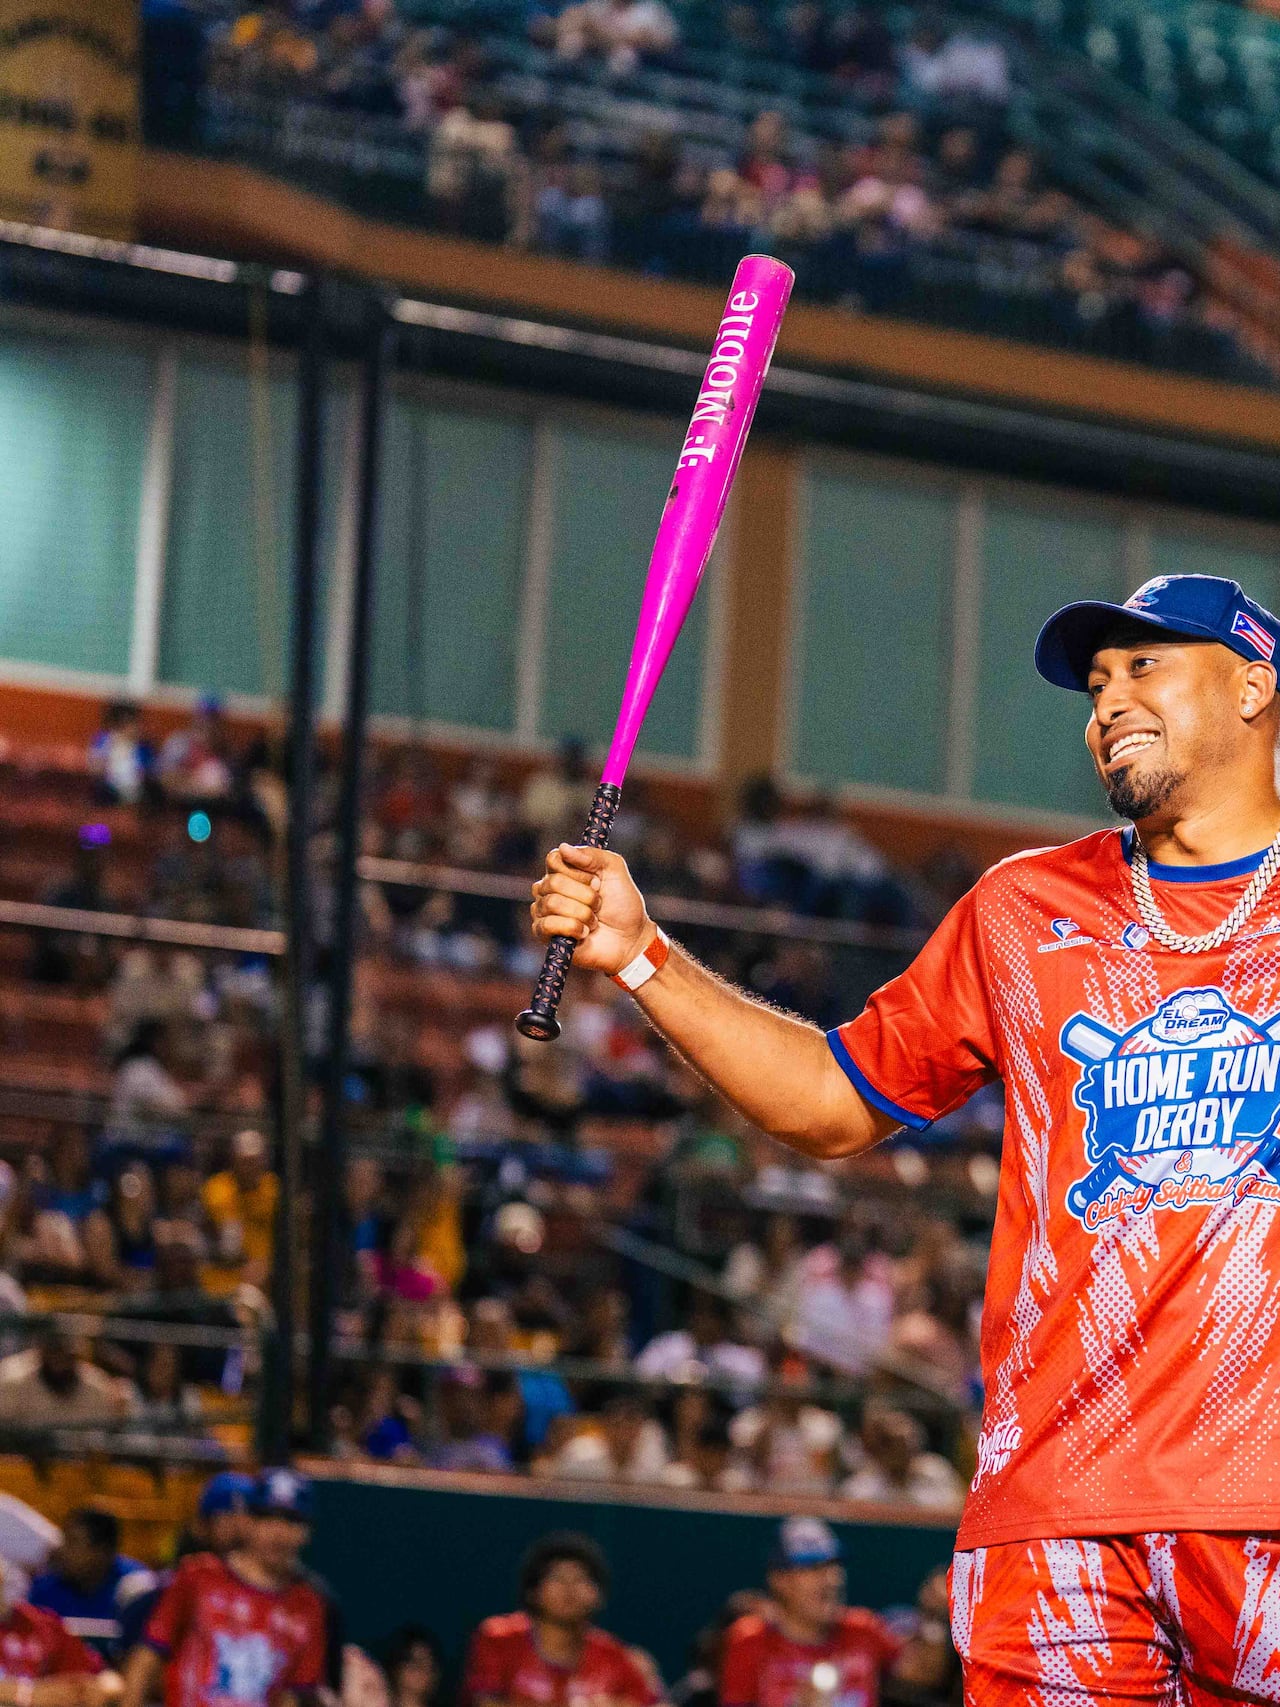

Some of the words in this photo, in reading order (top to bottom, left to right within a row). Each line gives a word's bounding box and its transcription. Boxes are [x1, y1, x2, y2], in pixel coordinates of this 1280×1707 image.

[1163, 1009, 1182, 1019] EL
[1164, 1015, 1224, 1029] DREAM
[1104, 1052, 1198, 1109] HOME
[1131, 1097, 1245, 1153] DERBY
[1156, 1176, 1237, 1206] Softball
